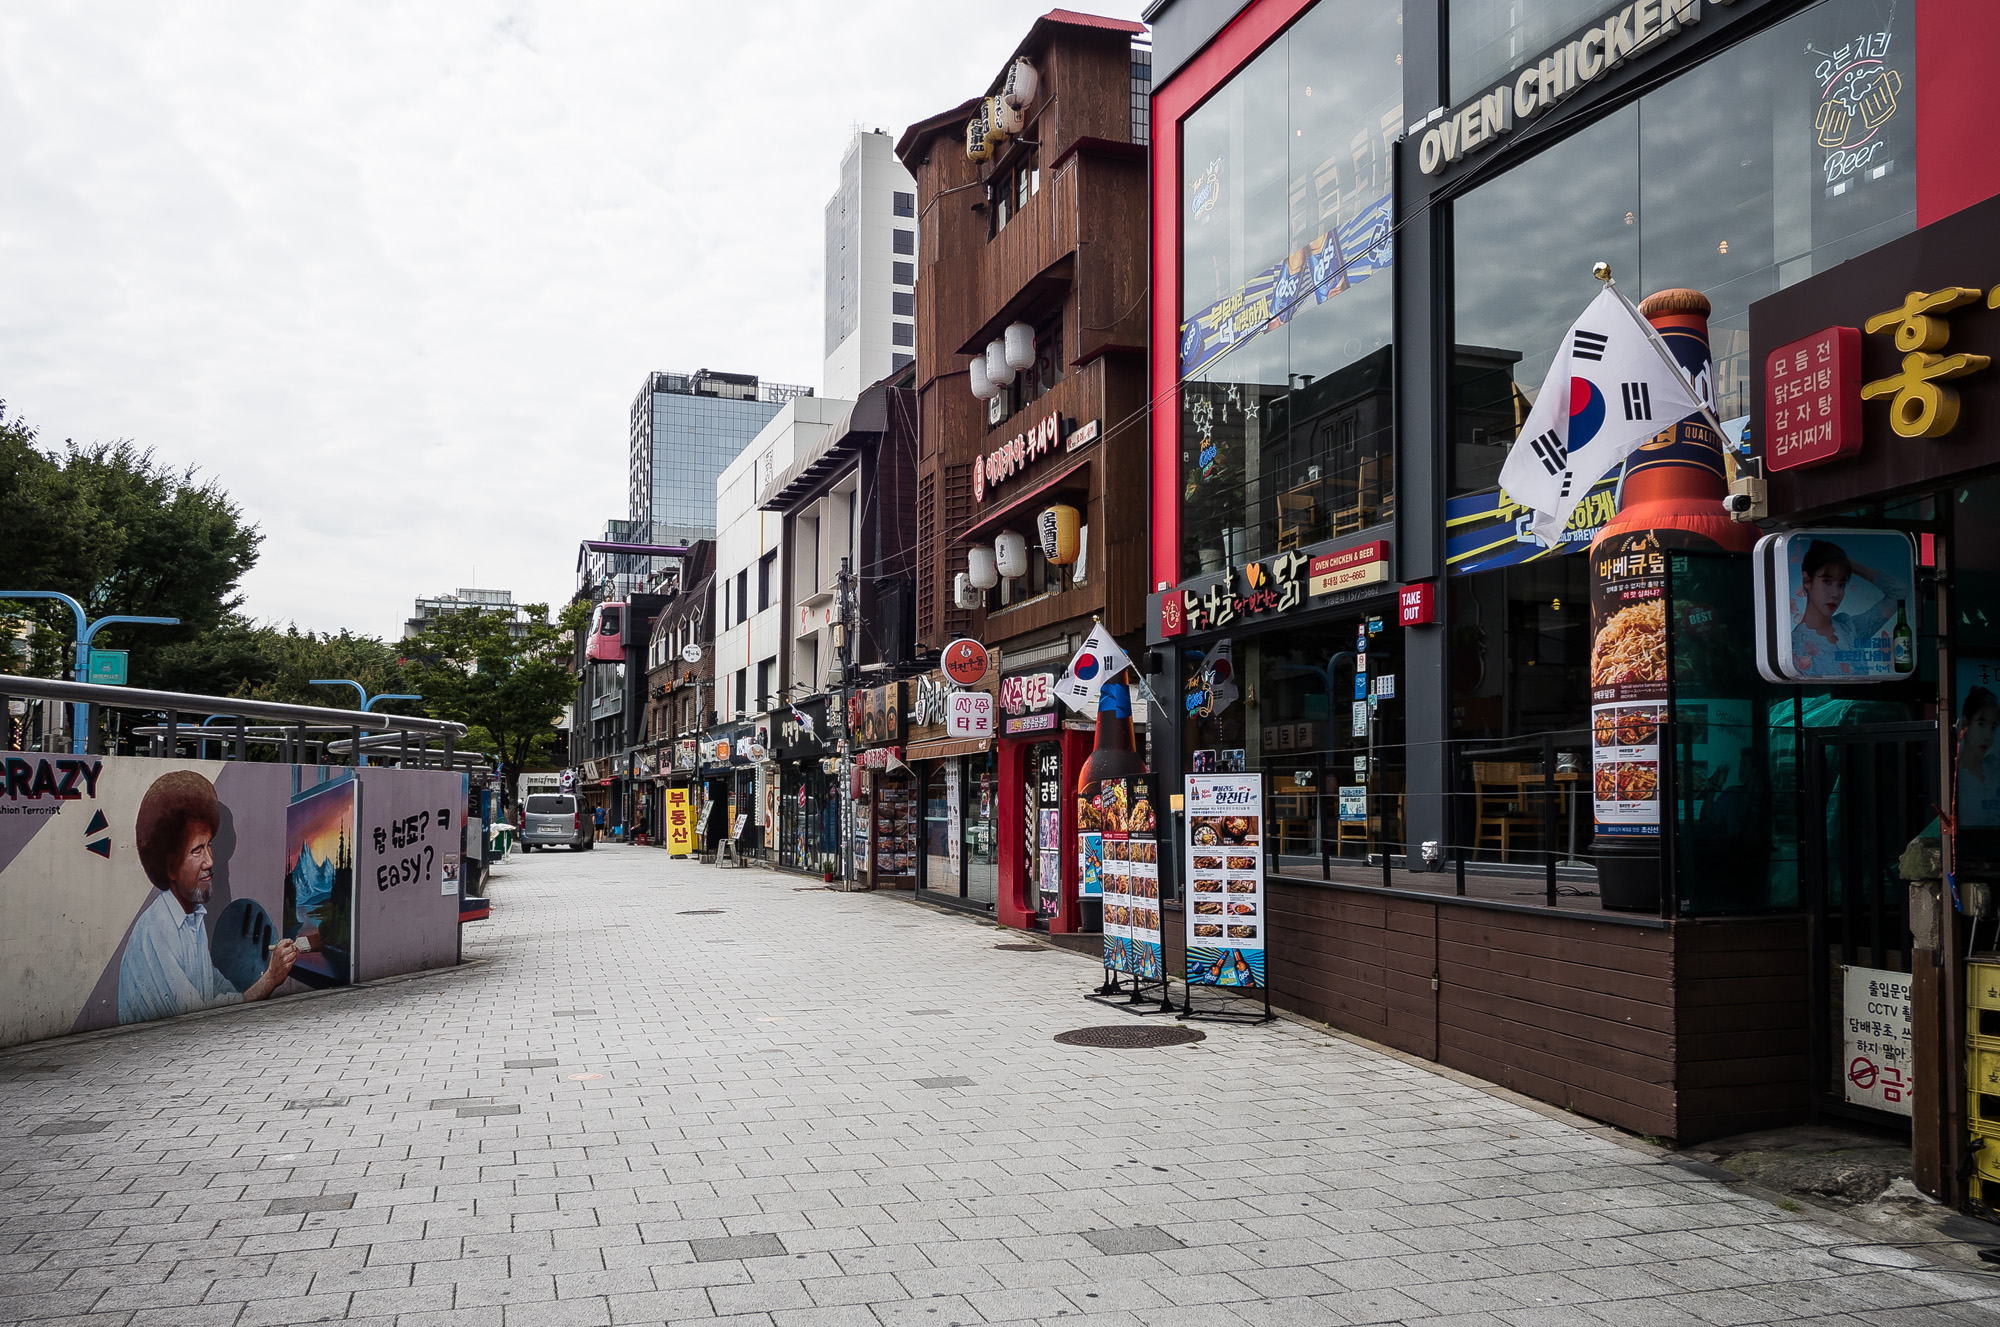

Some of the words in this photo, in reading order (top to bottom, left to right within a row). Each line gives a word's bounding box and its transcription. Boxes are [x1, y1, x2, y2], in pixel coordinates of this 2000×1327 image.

[1815, 32, 1892, 87] 오븐치킨
[1419, 86, 1512, 175] OVEN
[1514, 0, 1700, 118] CHICKEN
[1824, 141, 1884, 184] Beer
[1314, 237, 1334, 288] Cass
[1275, 276, 1299, 298] Cass
[1183, 322, 1196, 356] Cass
[1220, 317, 1235, 343] 더
[1861, 284, 2000, 437] 홍
[1774, 366, 1833, 406] 닭도리탕
[1685, 426, 1722, 448] QUALIT
[1775, 420, 1833, 456] 김치찌개
[986, 433, 1026, 487] 이자카야
[1314, 560, 1329, 571] OVEN
[1330, 553, 1353, 567] CHICKEN
[1354, 551, 1358, 561] &
[1359, 547, 1374, 559] BEER
[1322, 577, 1338, 589] 홍대점
[1402, 591, 1421, 606] TAKE
[1404, 606, 1419, 621] OUT
[1689, 611, 1713, 625] BEST
[1853, 637, 1891, 649] 이슬같이
[948, 656, 985, 673] 역전우동
[1041, 755, 1058, 777] 사주
[527, 775, 558, 785] innisfree
[1041, 780, 1058, 802] 궁합
[21, 805, 61, 816] Terrorist
[669, 791, 688, 844] 부동산
[377, 845, 434, 892] Easy?
[1867, 1001, 1899, 1017] CCTV
[1849, 1018, 1898, 1041] 담배꽁초,
[1901, 1027, 1911, 1041] 쓰
[1856, 1040, 1878, 1055] 하지
[1882, 1043, 1906, 1060] 말아
